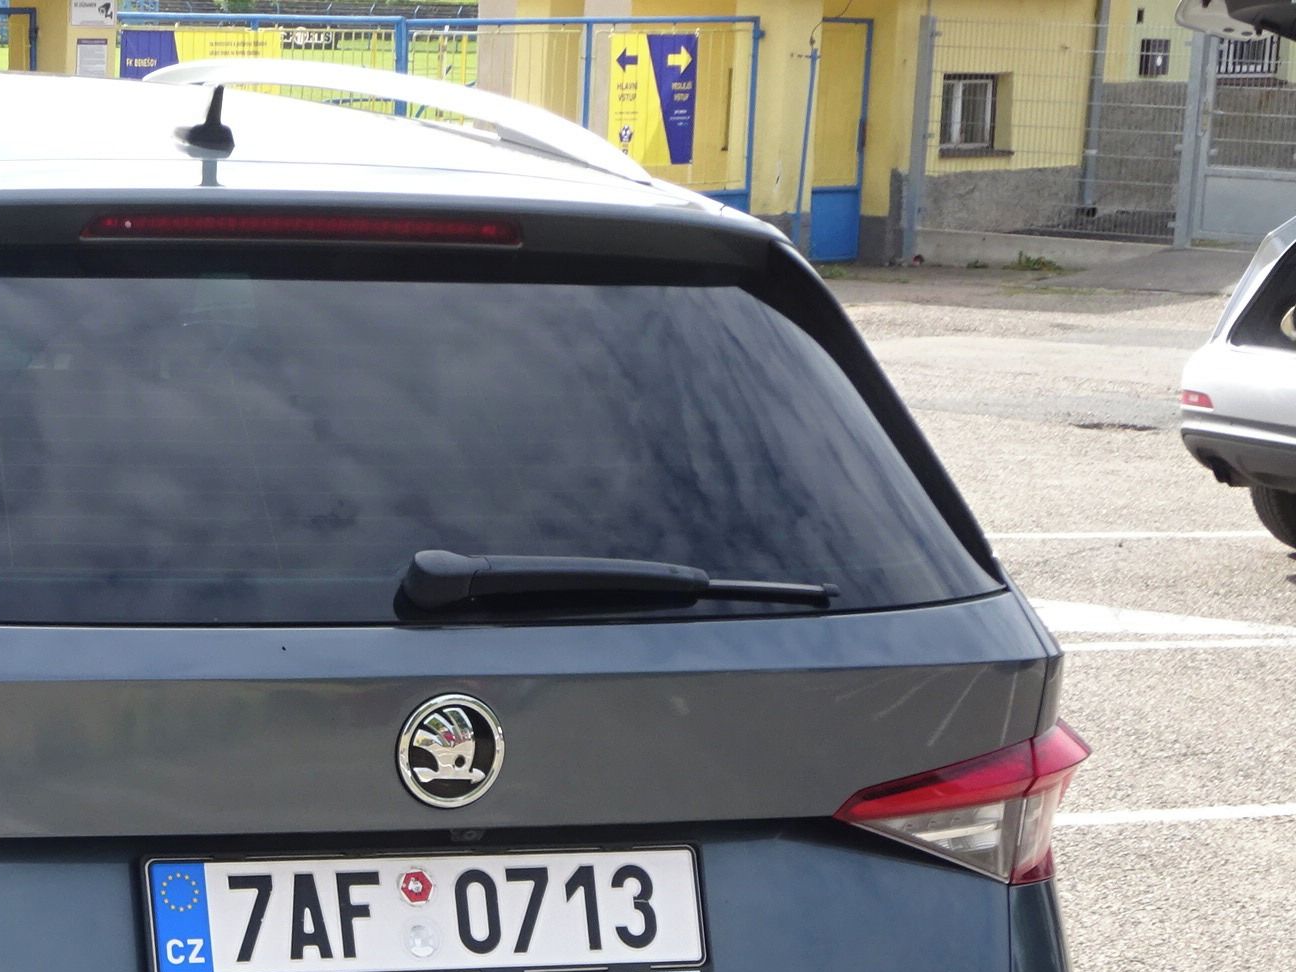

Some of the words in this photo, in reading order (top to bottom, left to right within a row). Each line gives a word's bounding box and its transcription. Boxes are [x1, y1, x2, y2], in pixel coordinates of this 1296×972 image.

[227, 871, 381, 962] 7AF
[454, 864, 659, 955] 0713
[166, 938, 206, 965] CZ
